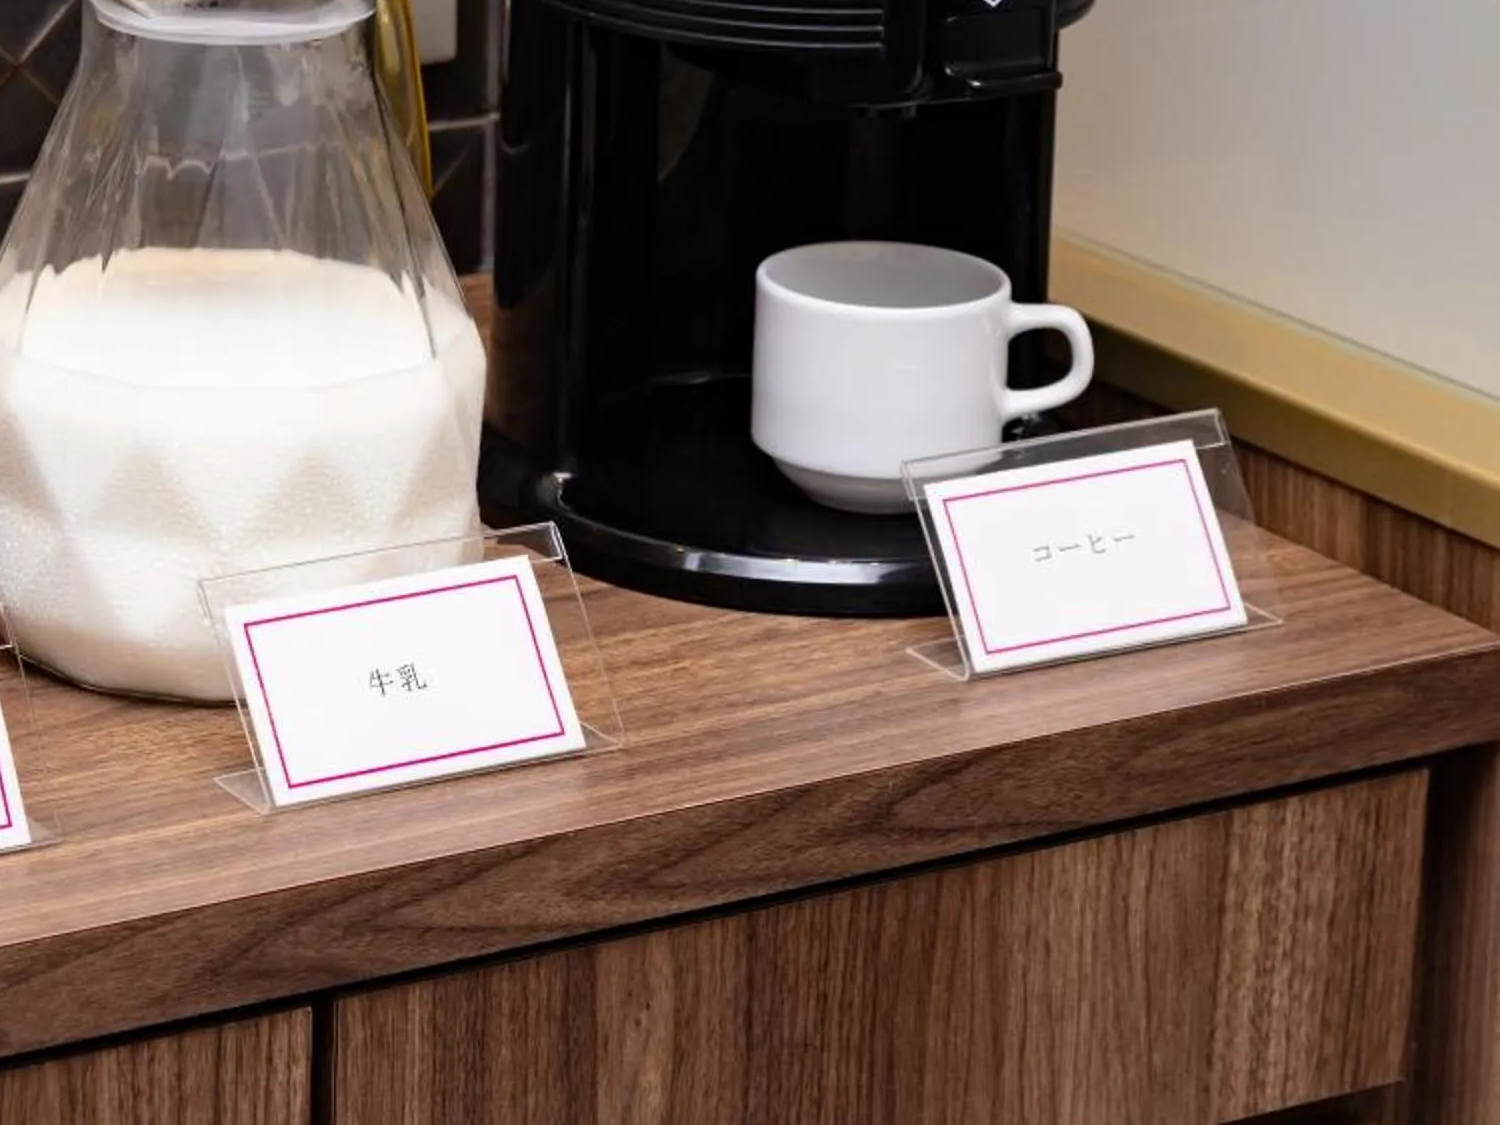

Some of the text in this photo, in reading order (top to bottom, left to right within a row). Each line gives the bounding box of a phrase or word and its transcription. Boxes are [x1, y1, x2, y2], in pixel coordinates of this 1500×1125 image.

[1032, 533, 1136, 562] コーヒー
[369, 662, 428, 696] 牛乳
